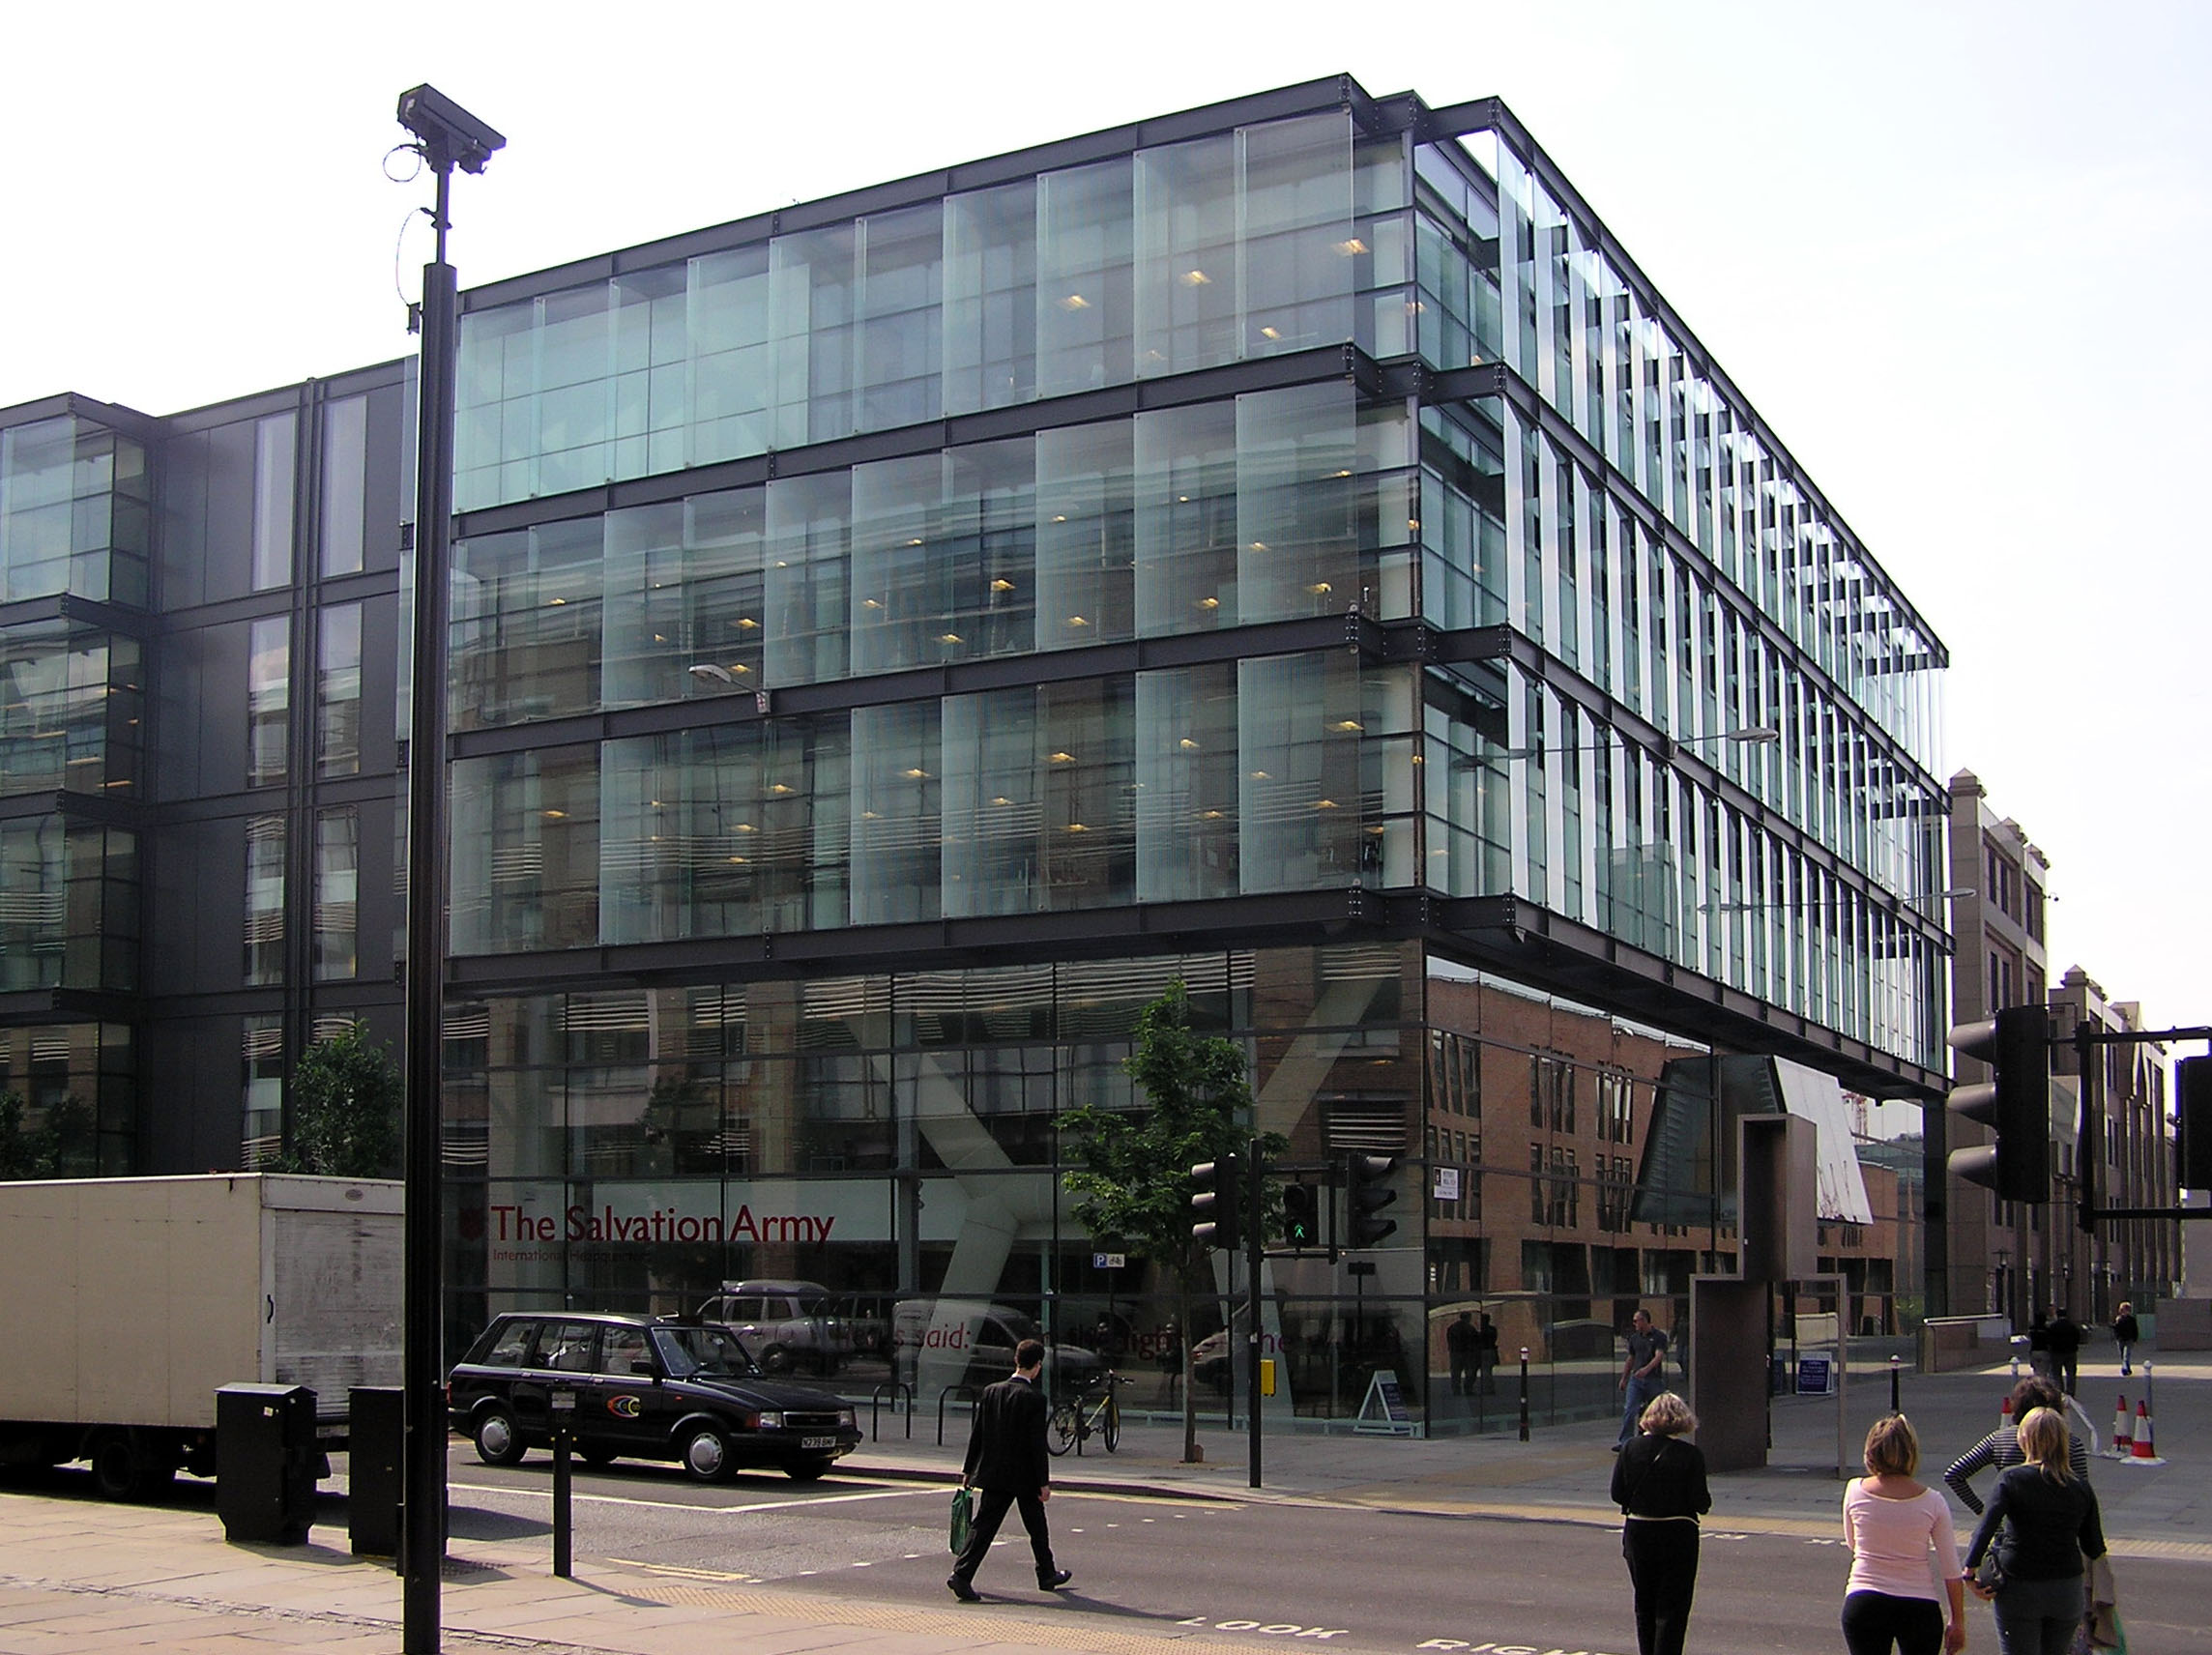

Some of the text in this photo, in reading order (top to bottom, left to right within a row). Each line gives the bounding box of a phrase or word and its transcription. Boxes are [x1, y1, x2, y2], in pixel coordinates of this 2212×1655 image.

[491, 1205, 836, 1253] The Salvation Army
[1096, 1255, 1105, 1266] P
[1176, 1616, 1628, 1655] LOOK RIGH
